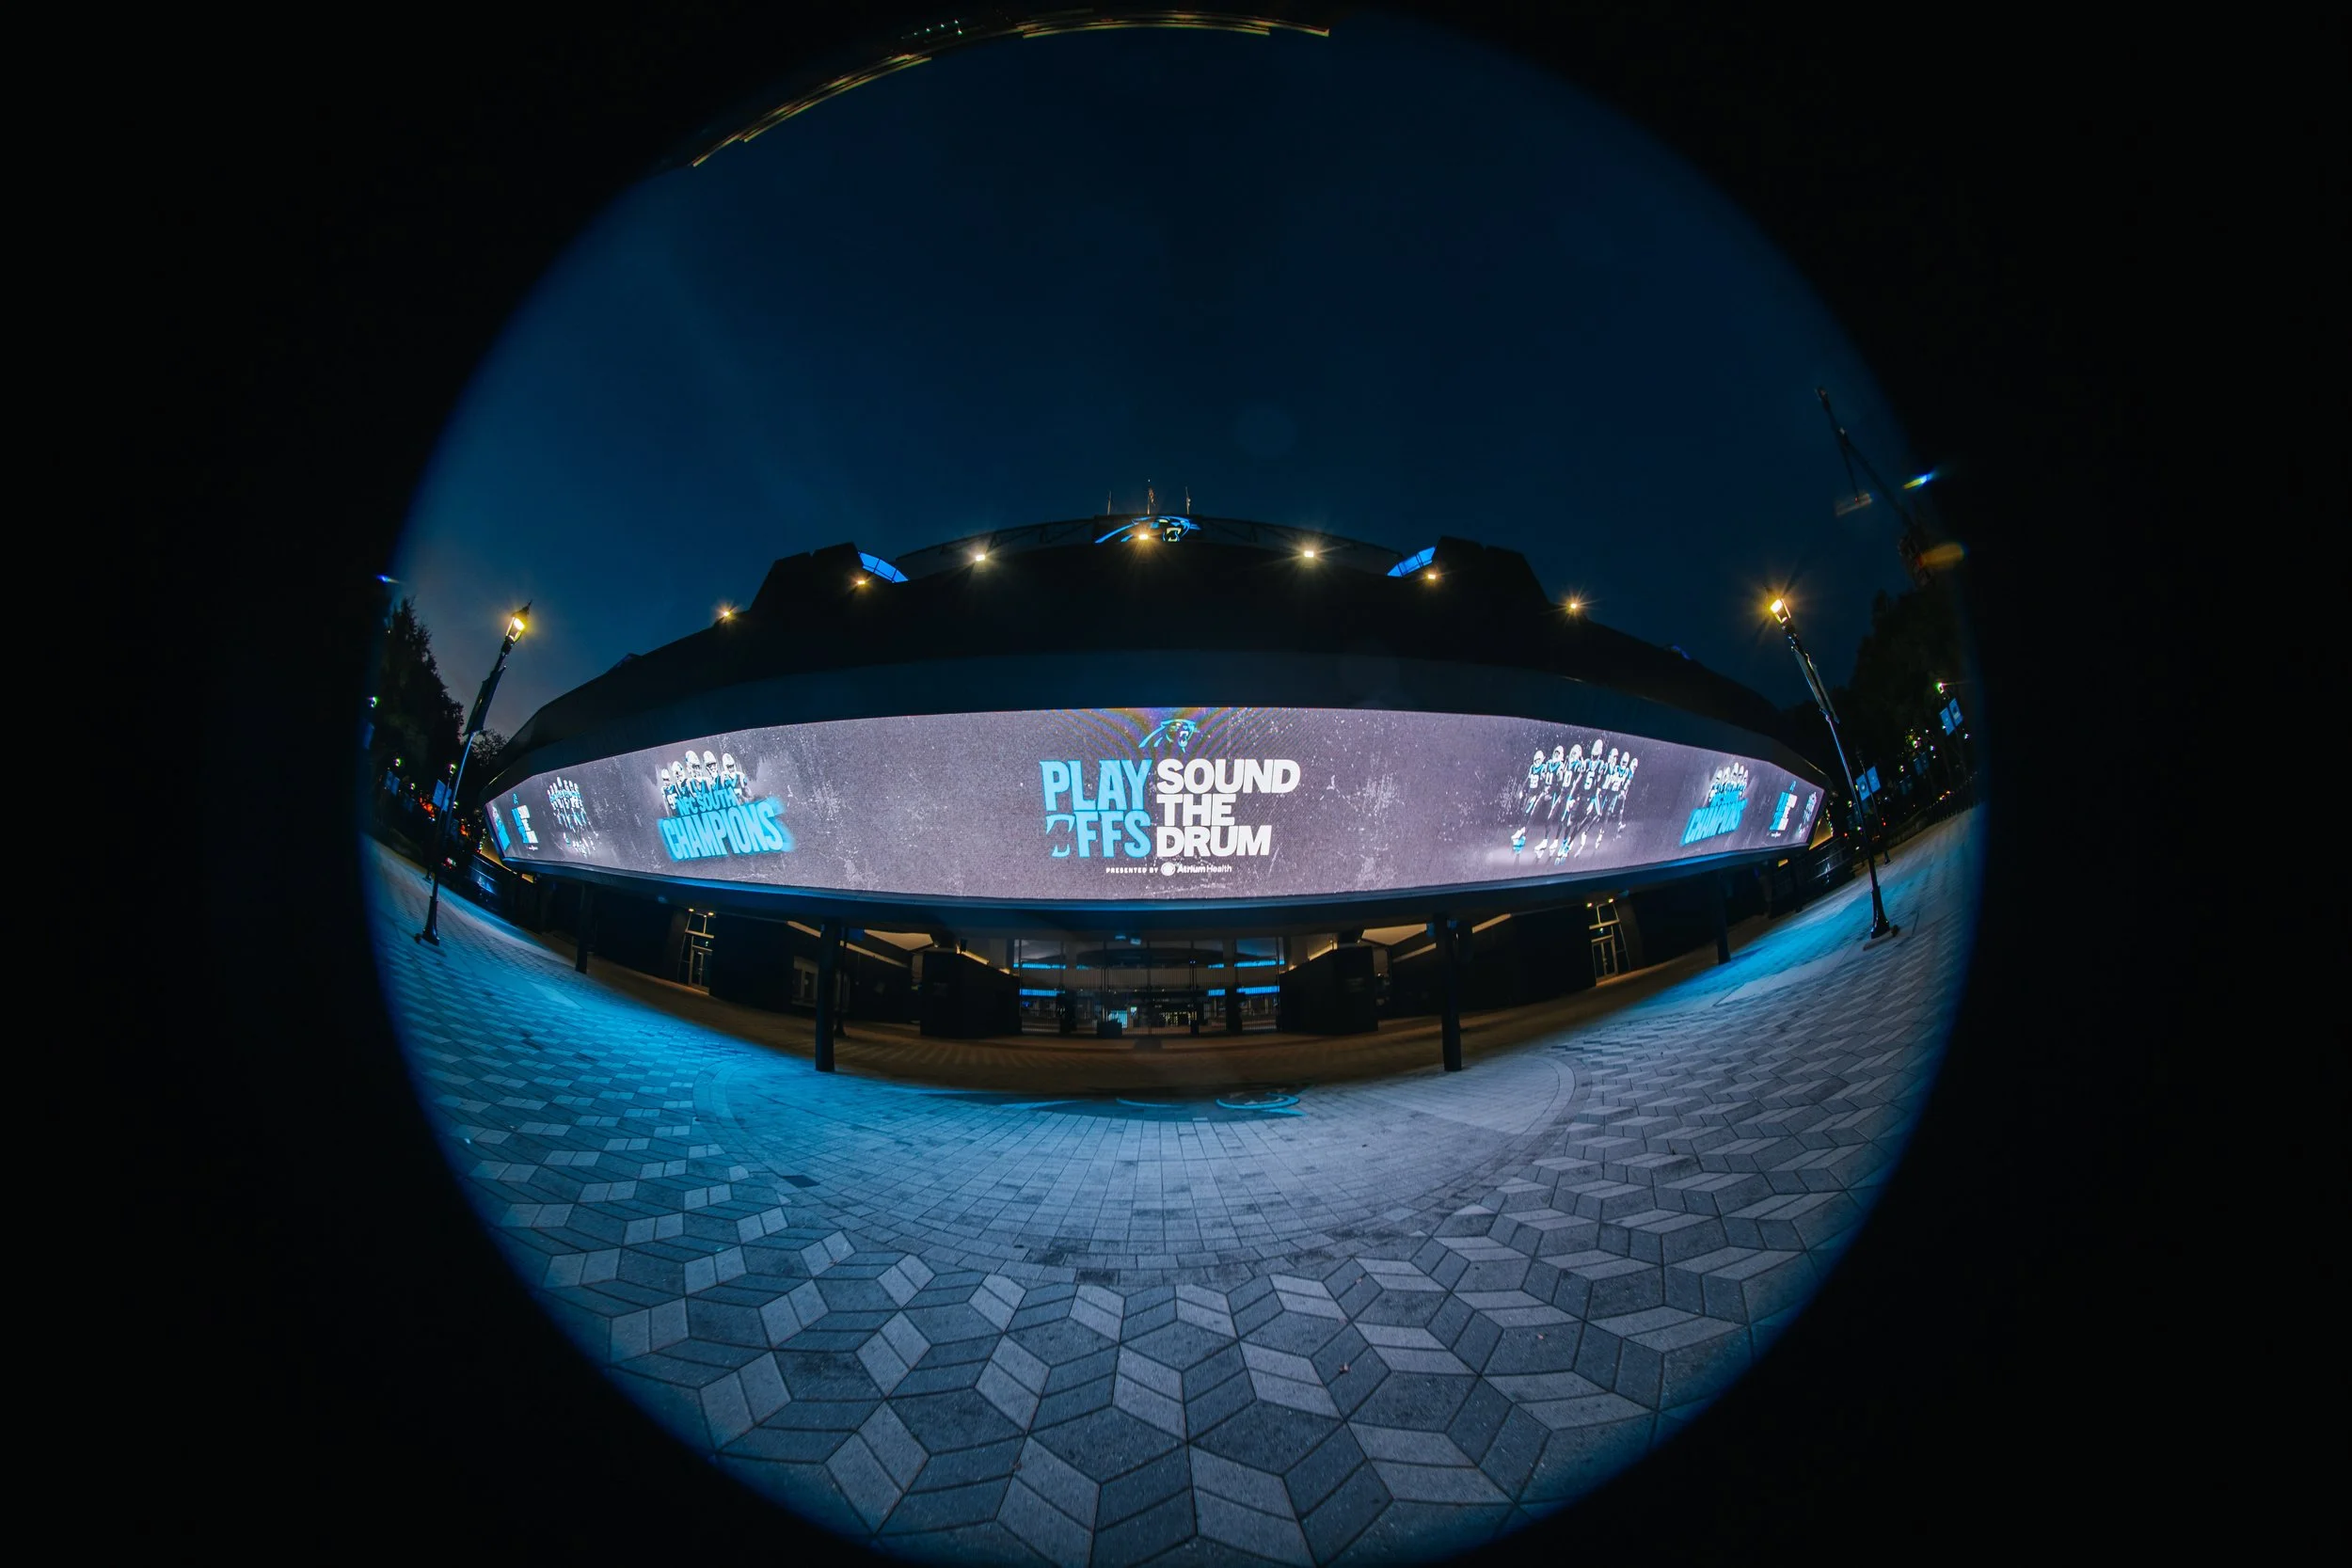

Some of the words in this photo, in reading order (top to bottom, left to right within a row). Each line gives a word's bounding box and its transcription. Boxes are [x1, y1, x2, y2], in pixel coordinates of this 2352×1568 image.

[1040, 759, 1152, 811] PLAY
[1157, 758, 1301, 794] SOUND
[677, 796, 698, 816] NFC
[697, 786, 737, 813] SOUTH
[1157, 793, 1236, 827] THE
[662, 801, 784, 860] CHAMPIONS
[1156, 825, 1272, 858] DRUM
[1177, 863, 1205, 874] Atrium
[1206, 863, 1232, 874] Health
